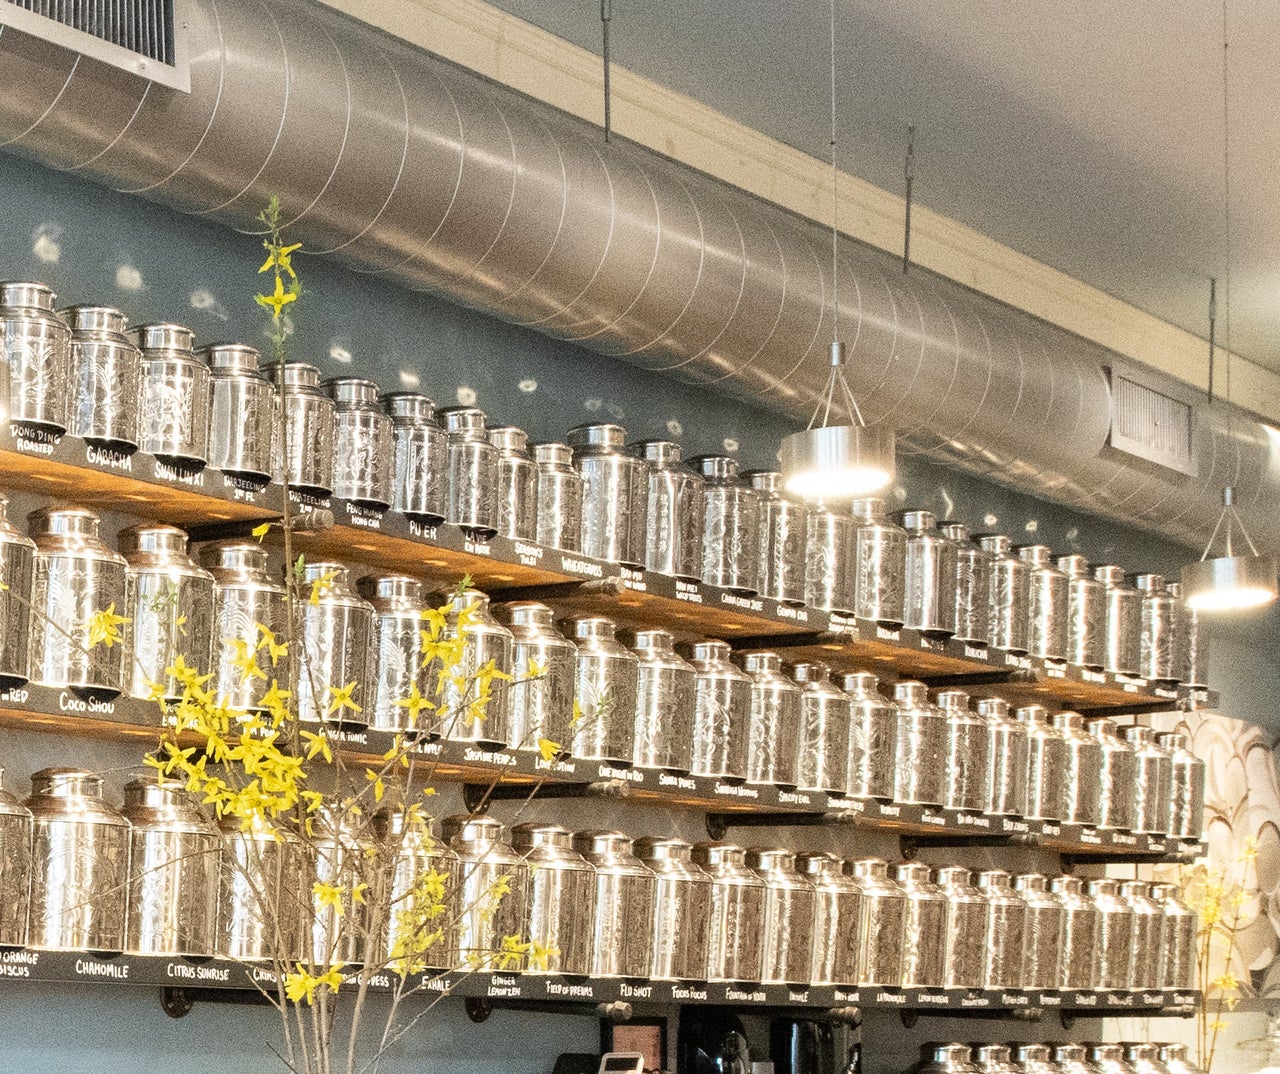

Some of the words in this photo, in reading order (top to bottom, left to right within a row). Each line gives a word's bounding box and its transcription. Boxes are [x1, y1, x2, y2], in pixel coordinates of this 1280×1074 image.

[10, 424, 36, 440] DONG
[37, 430, 61, 445] DING
[17, 438, 54, 455] ROASTED
[86, 445, 133, 472] GABACHA
[224, 474, 266, 494] DARJEELING
[289, 490, 331, 508] DARJEELING
[409, 520, 421, 536] PU
[423, 526, 437, 541] ER
[9, 687, 28, 703] RED
[3, 951, 39, 965] ORANGE
[75, 959, 129, 979] CHAMOMILE
[167, 963, 196, 979] CITRUS
[197, 965, 229, 981] SUNRISE
[492, 975, 516, 987] GINGER
[546, 981, 562, 993] FIELD
[620, 983, 633, 997] FLU
[634, 985, 652, 998] SHOT
